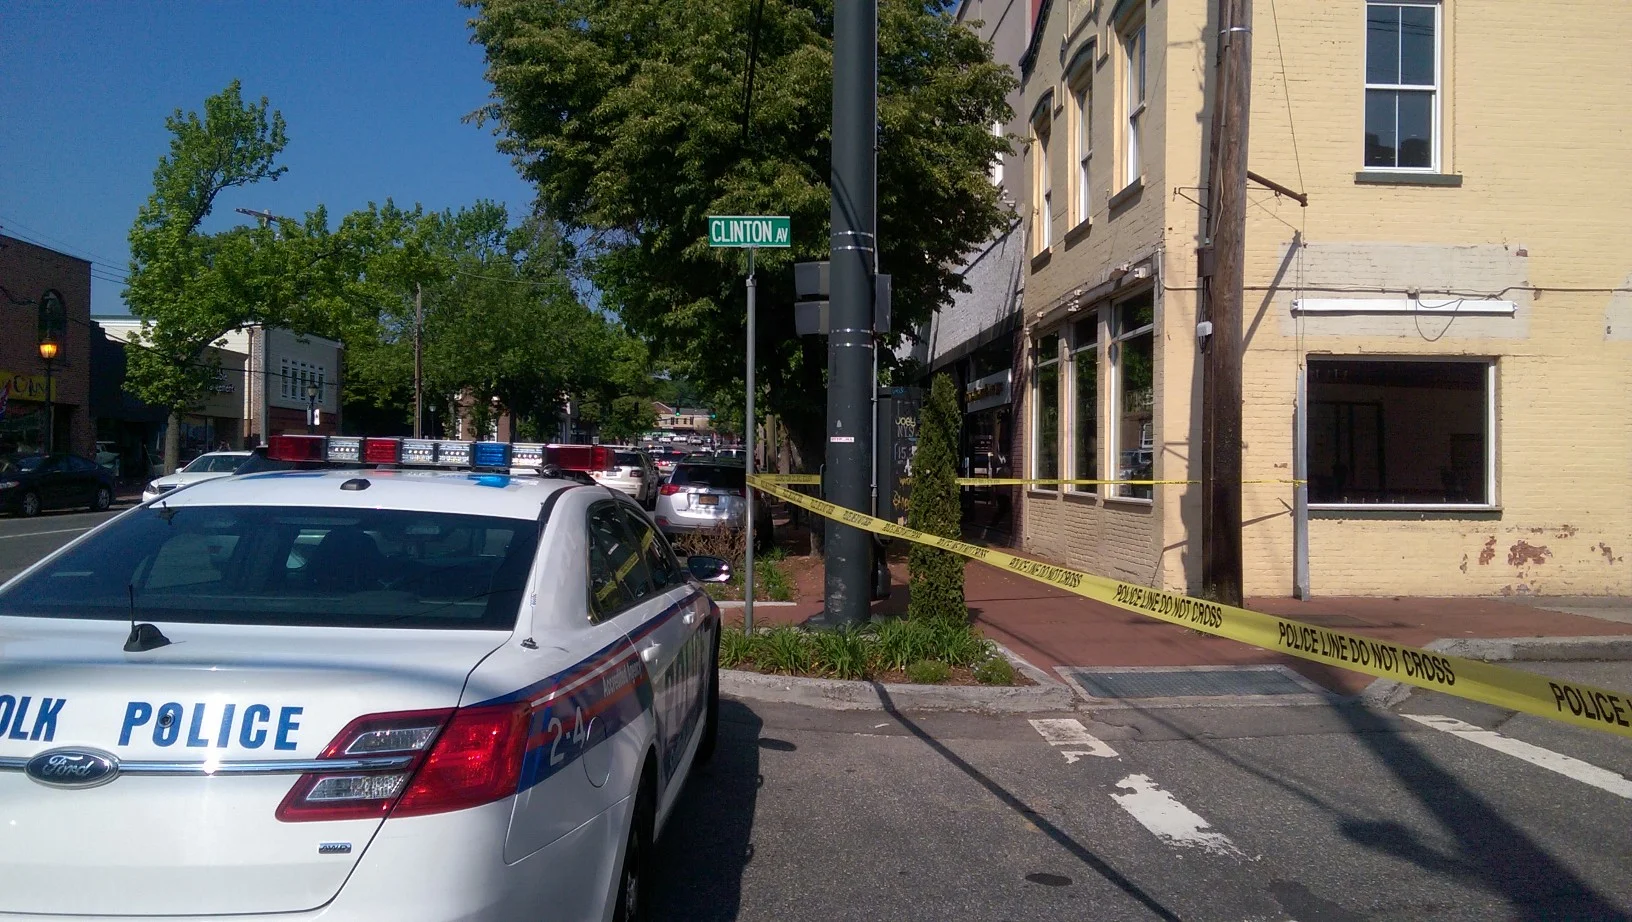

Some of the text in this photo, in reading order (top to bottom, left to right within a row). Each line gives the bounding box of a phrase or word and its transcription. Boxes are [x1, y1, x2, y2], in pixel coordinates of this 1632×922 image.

[712, 220, 788, 242] CLINTON AV
[1060, 571, 1083, 588] CROSS
[1112, 584, 1223, 628] POLICE LINE DO NOT CROSS
[1278, 621, 1455, 686] POLICE LINE DO NOT CROSS
[1549, 682, 1630, 727] POLICE
[118, 701, 303, 750] POLICE
[43, 755, 94, 775] Ford
[320, 844, 349, 852] AWD
